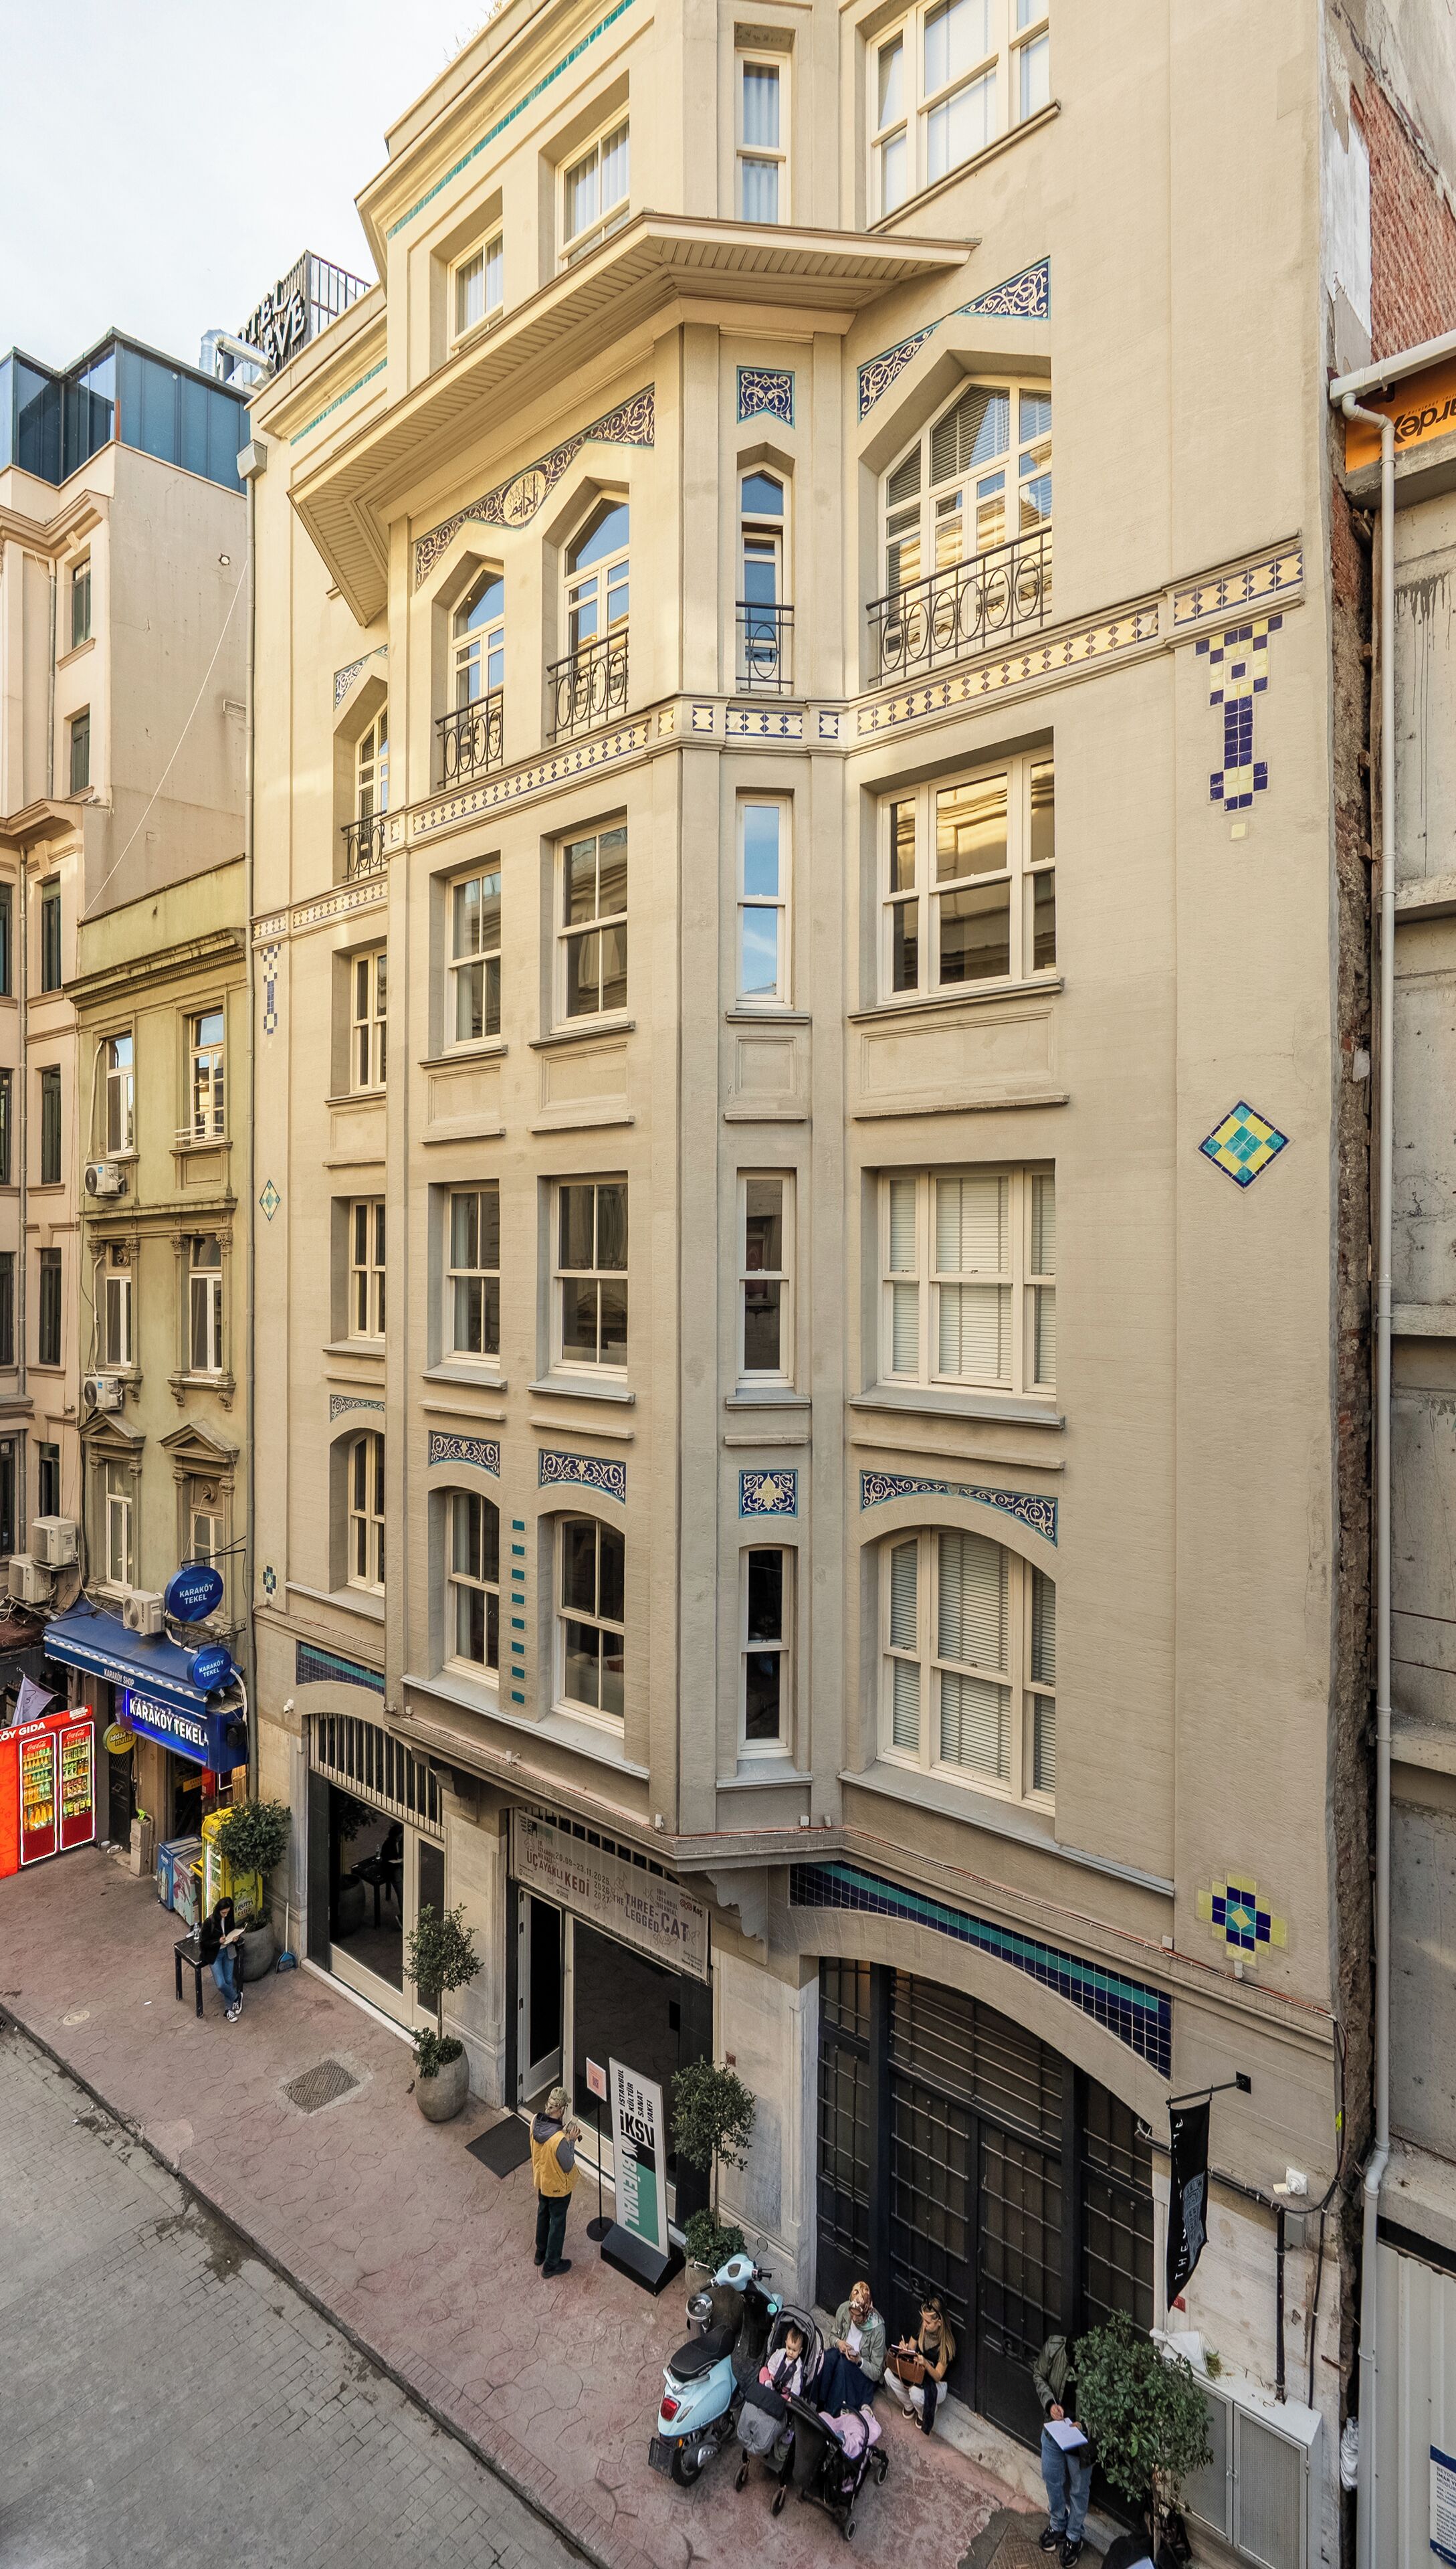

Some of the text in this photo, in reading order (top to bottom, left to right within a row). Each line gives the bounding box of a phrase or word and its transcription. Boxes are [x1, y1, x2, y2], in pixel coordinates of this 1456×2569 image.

[179, 1584, 214, 1598] KARAKÖY
[184, 1594, 207, 1605] TEKEL
[199, 1659, 224, 1673] KARAKÖY
[203, 1668, 220, 1678] TEKEL
[104, 1668, 134, 1687] KARAKÖY SHOP
[0, 1721, 46, 1742] ÖY GIDA
[130, 1698, 205, 1747] KARAKÖY TEKEL
[526, 1850, 538, 1871] ÜÇ
[539, 1860, 563, 1880] AYAKLI
[564, 1871, 590, 1897] KEDİ
[594, 1891, 610, 1903] 2027
[613, 1894, 624, 1906] THE
[625, 1907, 690, 1942] LEGGED CAT
[617, 2069, 625, 2107] İSTANBUL
[626, 2082, 634, 2112] KÜLTÜR
